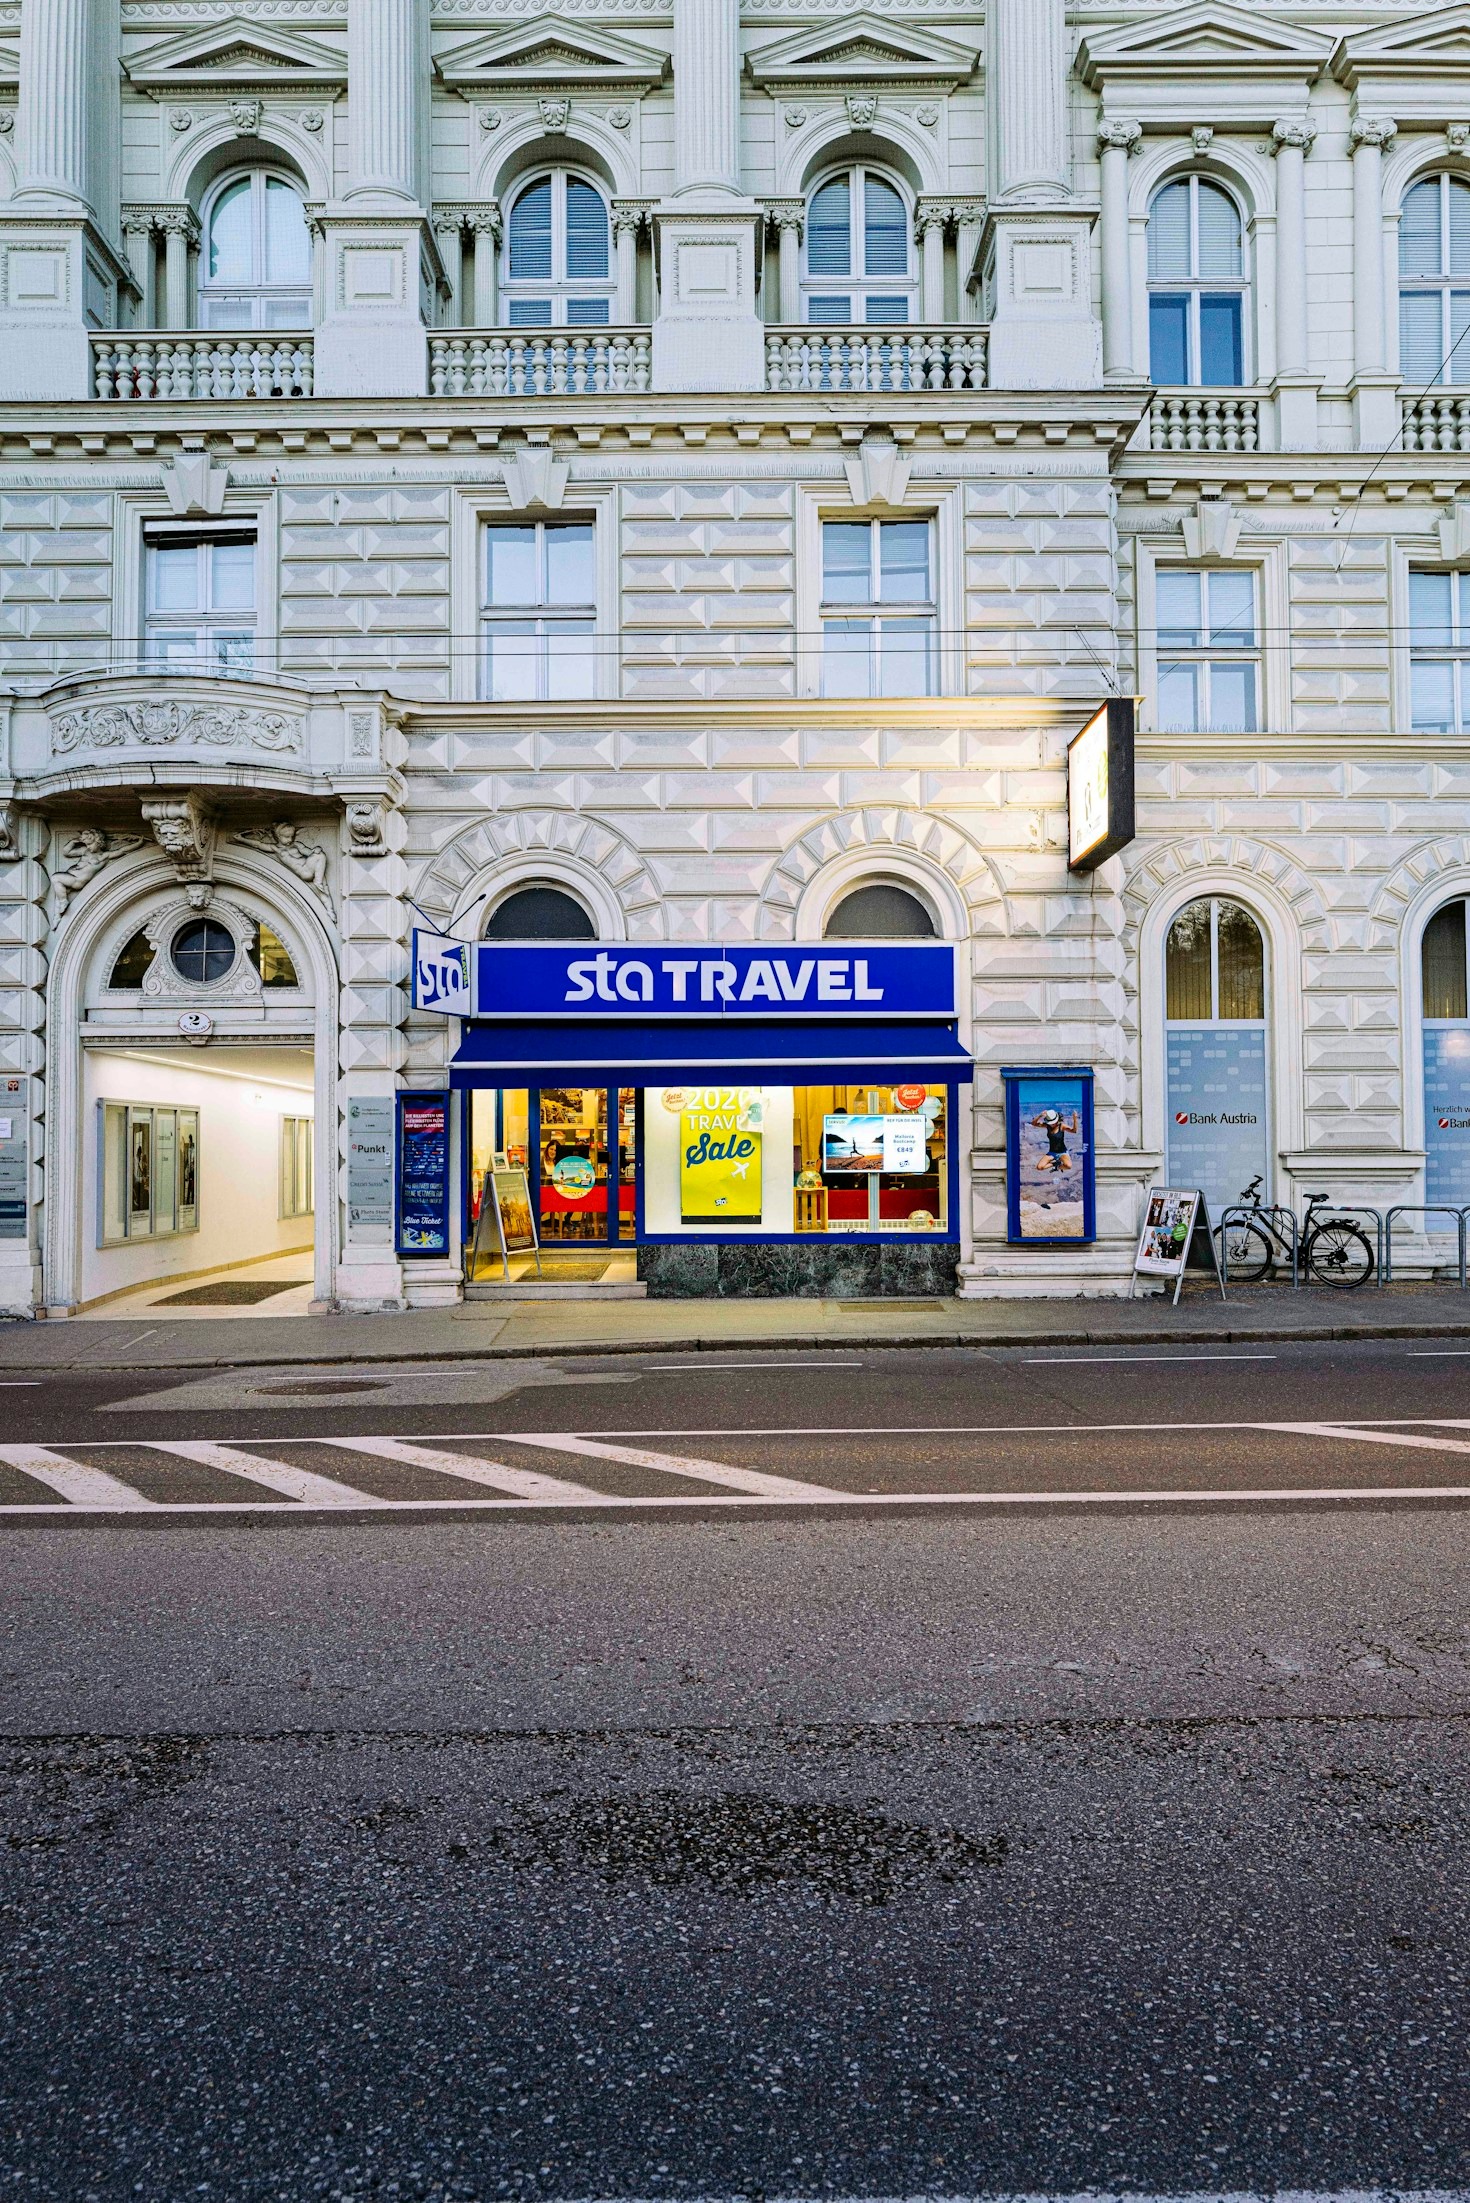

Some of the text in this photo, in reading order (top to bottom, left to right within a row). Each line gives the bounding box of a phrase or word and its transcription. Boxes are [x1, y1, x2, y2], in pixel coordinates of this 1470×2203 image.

[419, 951, 464, 1001] sta
[460, 946, 469, 989] TRAVEL
[564, 952, 885, 1001] sta TRAVEL
[189, 1015, 200, 1026] 2
[1189, 1112, 1257, 1124] Bank Austria
[1433, 1105, 1463, 1113] Herzlich
[686, 1132, 756, 1168] Sale
[404, 1216, 420, 1224] Blue
